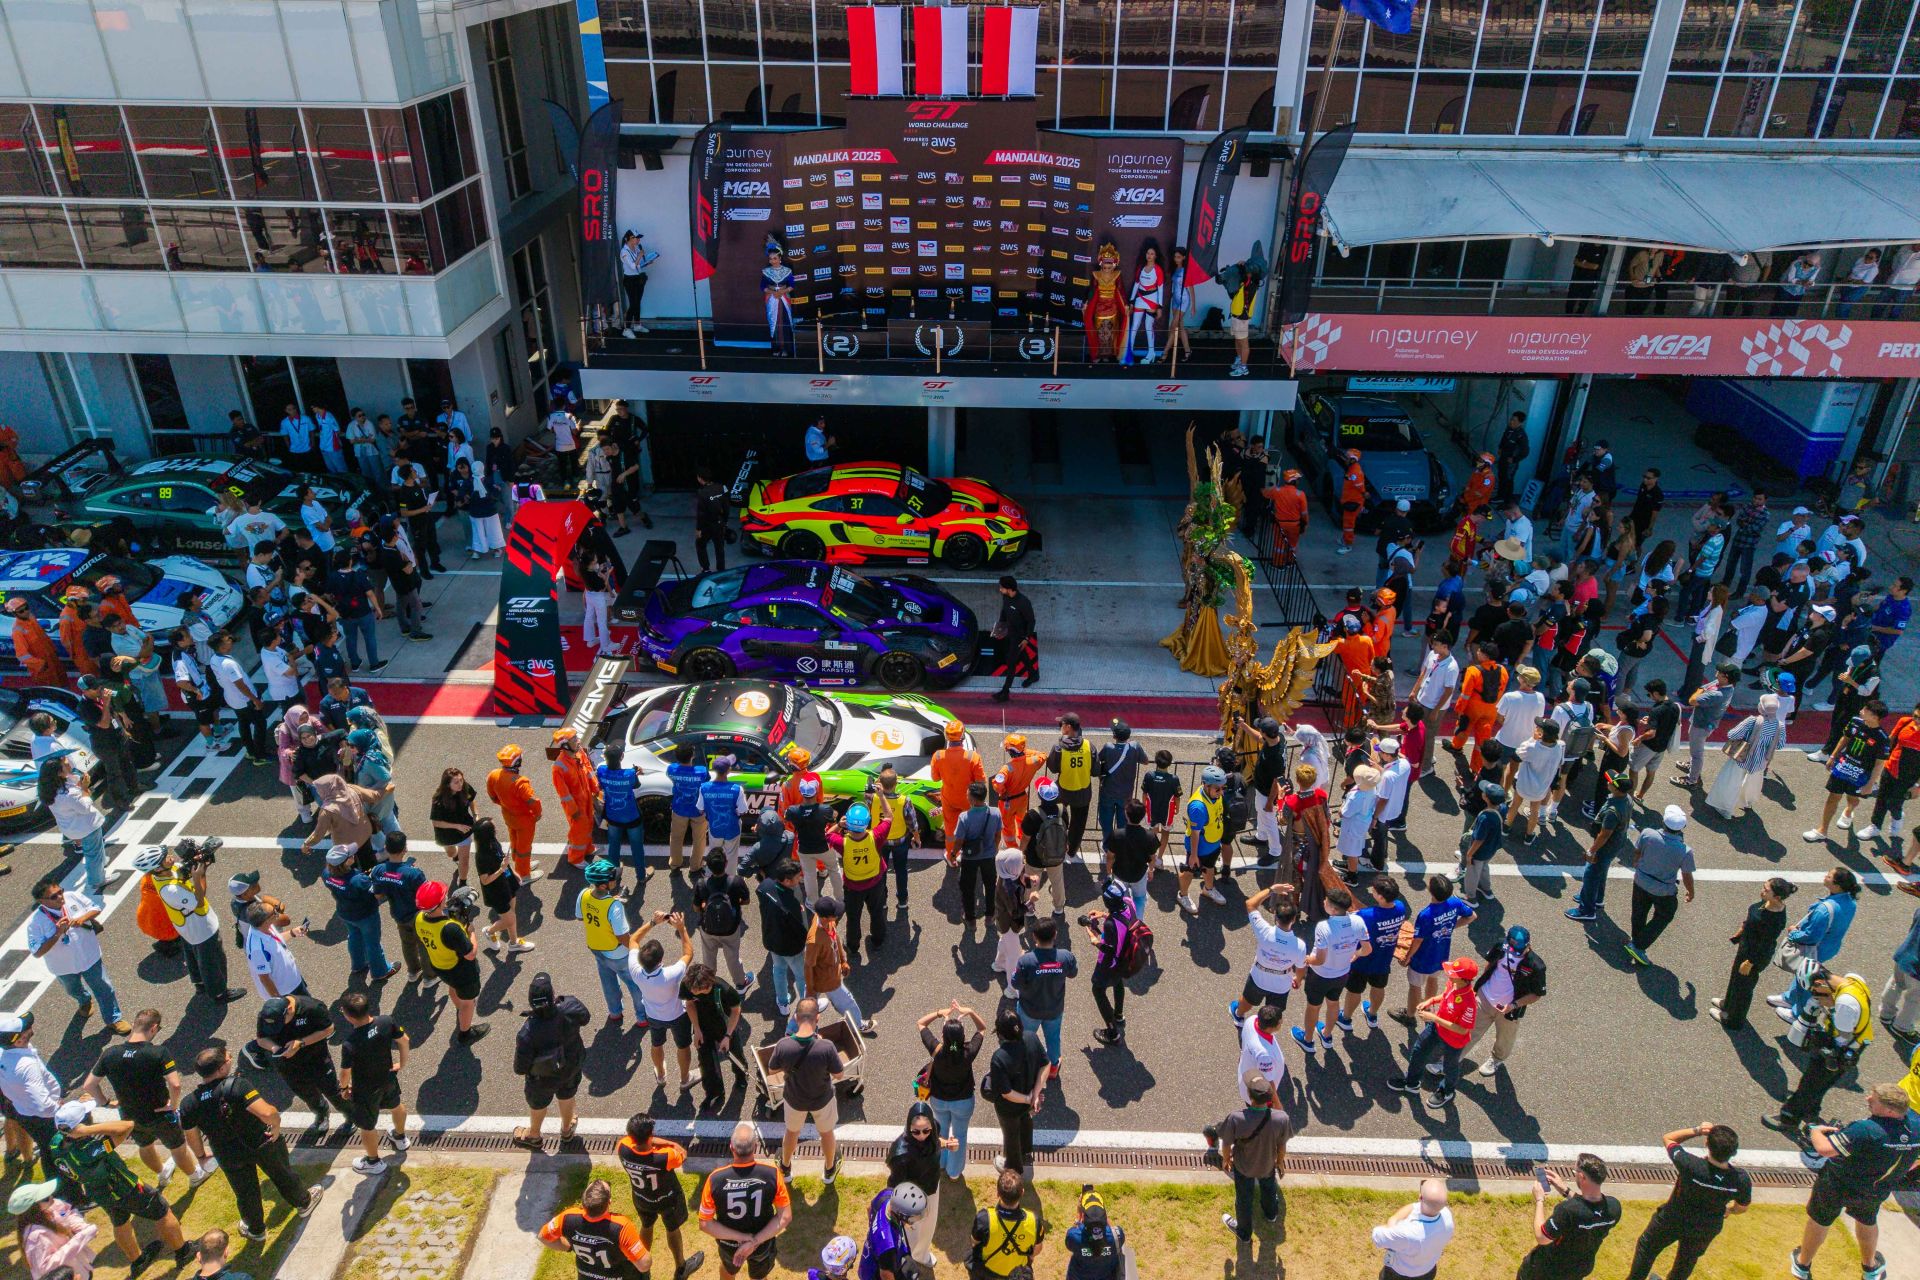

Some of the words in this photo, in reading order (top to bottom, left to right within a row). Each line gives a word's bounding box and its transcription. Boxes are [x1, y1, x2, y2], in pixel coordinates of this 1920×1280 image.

[904, 102, 977, 120] GT
[707, 133, 716, 155] aws
[931, 137, 956, 147] aws
[1219, 140, 1232, 162] aws
[794, 152, 849, 166] MANDALIKA
[851, 151, 881, 162] 2025
[995, 152, 1053, 165] MANDALIKA
[1056, 156, 1081, 168] 2025
[1108, 155, 1172, 168] injourney
[810, 174, 827, 182] aws
[723, 181, 770, 195] MGPA
[1116, 188, 1165, 202] MGPA
[584, 169, 602, 241] SRO
[697, 179, 713, 241] GT
[1054, 201, 1069, 209] aws
[1215, 195, 1224, 227] CHALLENGE
[973, 219, 991, 227] aws
[1197, 185, 1216, 248] GT
[1076, 228, 1092, 236] aws
[1291, 192, 1320, 263] SRO
[788, 248, 805, 256] aws
[1000, 243, 1018, 251] aws
[1027, 267, 1044, 275] aws
[946, 287, 963, 295] aws
[1051, 293, 1065, 301] aws
[833, 336, 850, 351] 2
[1029, 339, 1046, 354] 3
[1369, 329, 1478, 351] injourney
[1509, 333, 1592, 349] injourney
[1629, 335, 1711, 356] MGPA
[689, 376, 721, 384] GT
[809, 379, 841, 387] GT
[923, 381, 954, 389] GT
[1040, 383, 1071, 391] GT
[1156, 384, 1188, 392] GT
[1342, 425, 1365, 435] 500
[227, 457, 254, 478] WORLD
[159, 487, 173, 499] 89
[851, 498, 864, 509] 37
[907, 495, 924, 511] 37
[72, 553, 108, 579] WORLD
[830, 566, 841, 590] WORLD
[507, 597, 551, 608] GT
[769, 605, 777, 617] 4
[830, 606, 847, 618] 4
[527, 659, 554, 669] aws
[579, 659, 620, 723] AMG
[782, 685, 795, 723] WORLD
[767, 710, 787, 745] GT
[892, 729, 900, 741] JET
[1070, 757, 1084, 768] 85
[853, 855, 869, 865] 71
[586, 903, 599, 913] SRO
[586, 913, 600, 927] 95
[627, 1168, 658, 1191] 51
[726, 1189, 763, 1220] 51
[572, 1243, 612, 1269] 51
